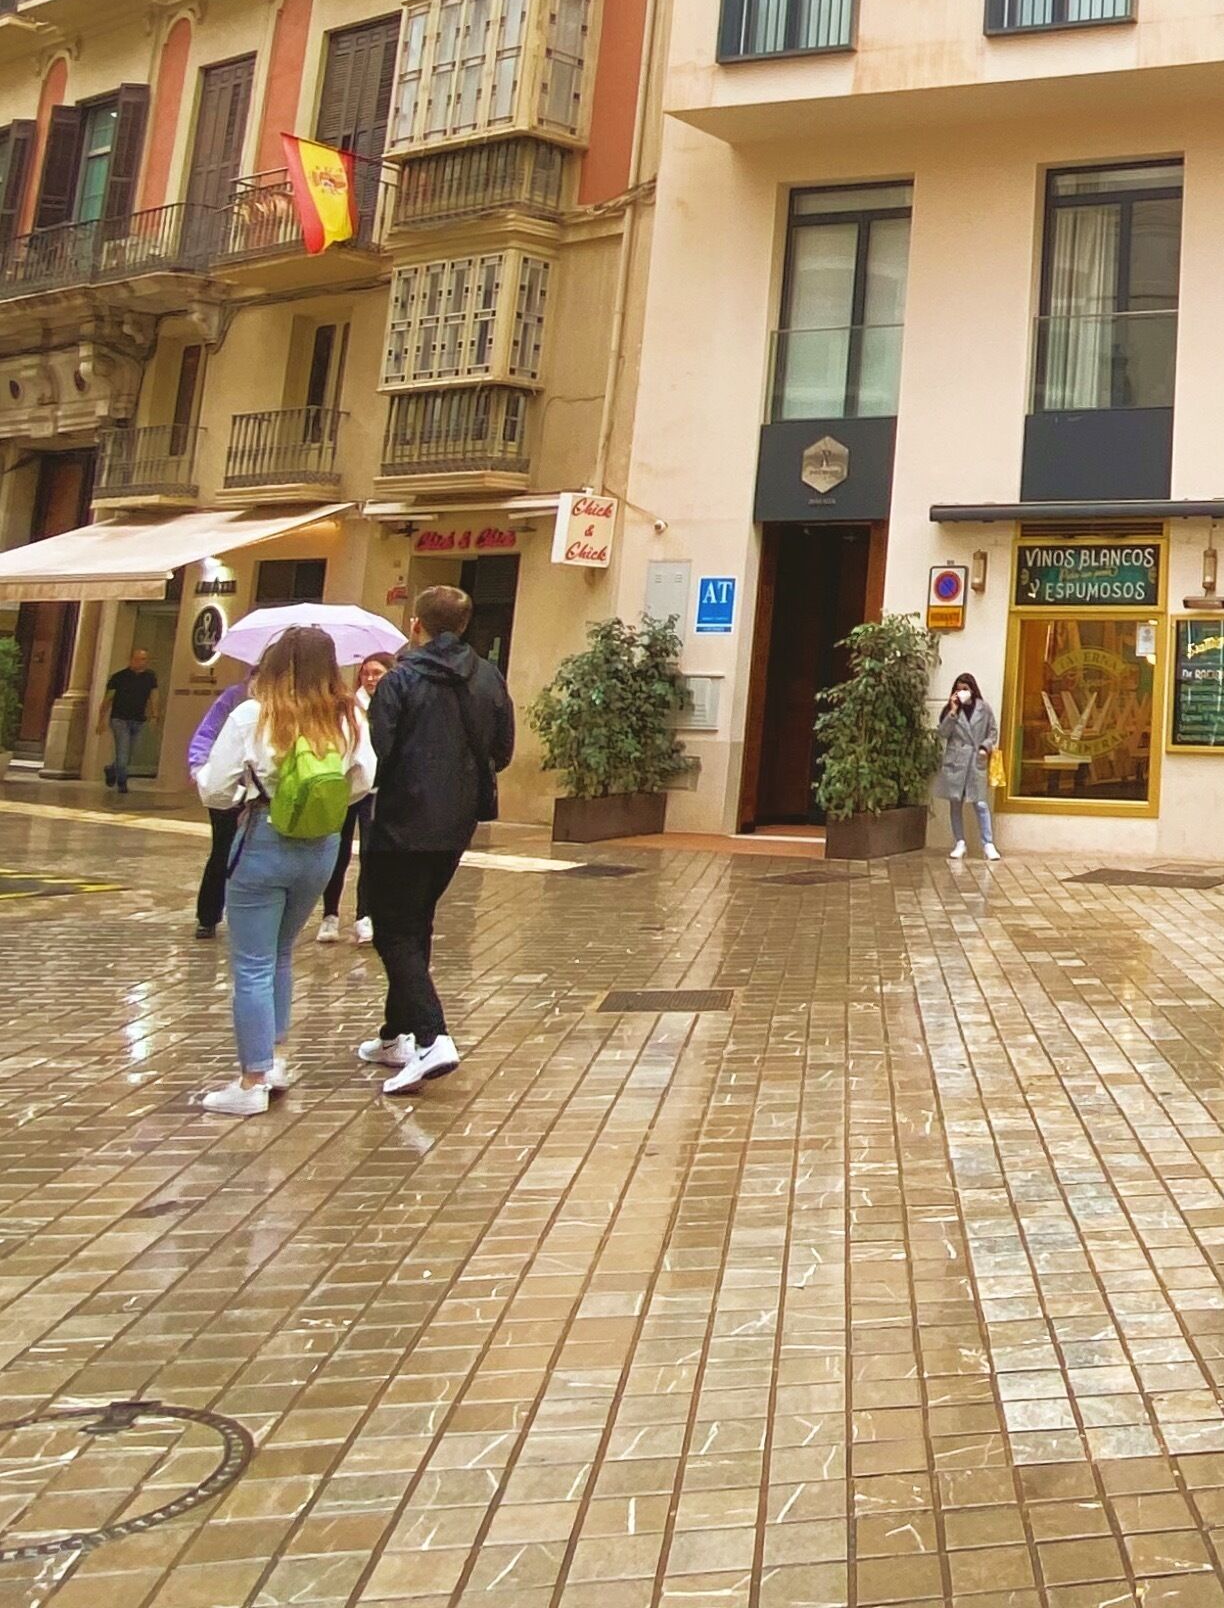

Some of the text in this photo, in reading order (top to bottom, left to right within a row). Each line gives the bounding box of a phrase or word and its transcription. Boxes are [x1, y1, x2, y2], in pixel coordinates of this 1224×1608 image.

[572, 498, 614, 519] Chick
[584, 525, 594, 537] &
[565, 541, 607, 562] Chick
[1025, 548, 1154, 570] VINOS BLANCOS
[702, 581, 733, 604] AT
[1028, 578, 1145, 601] Y ESPUMOSOS
